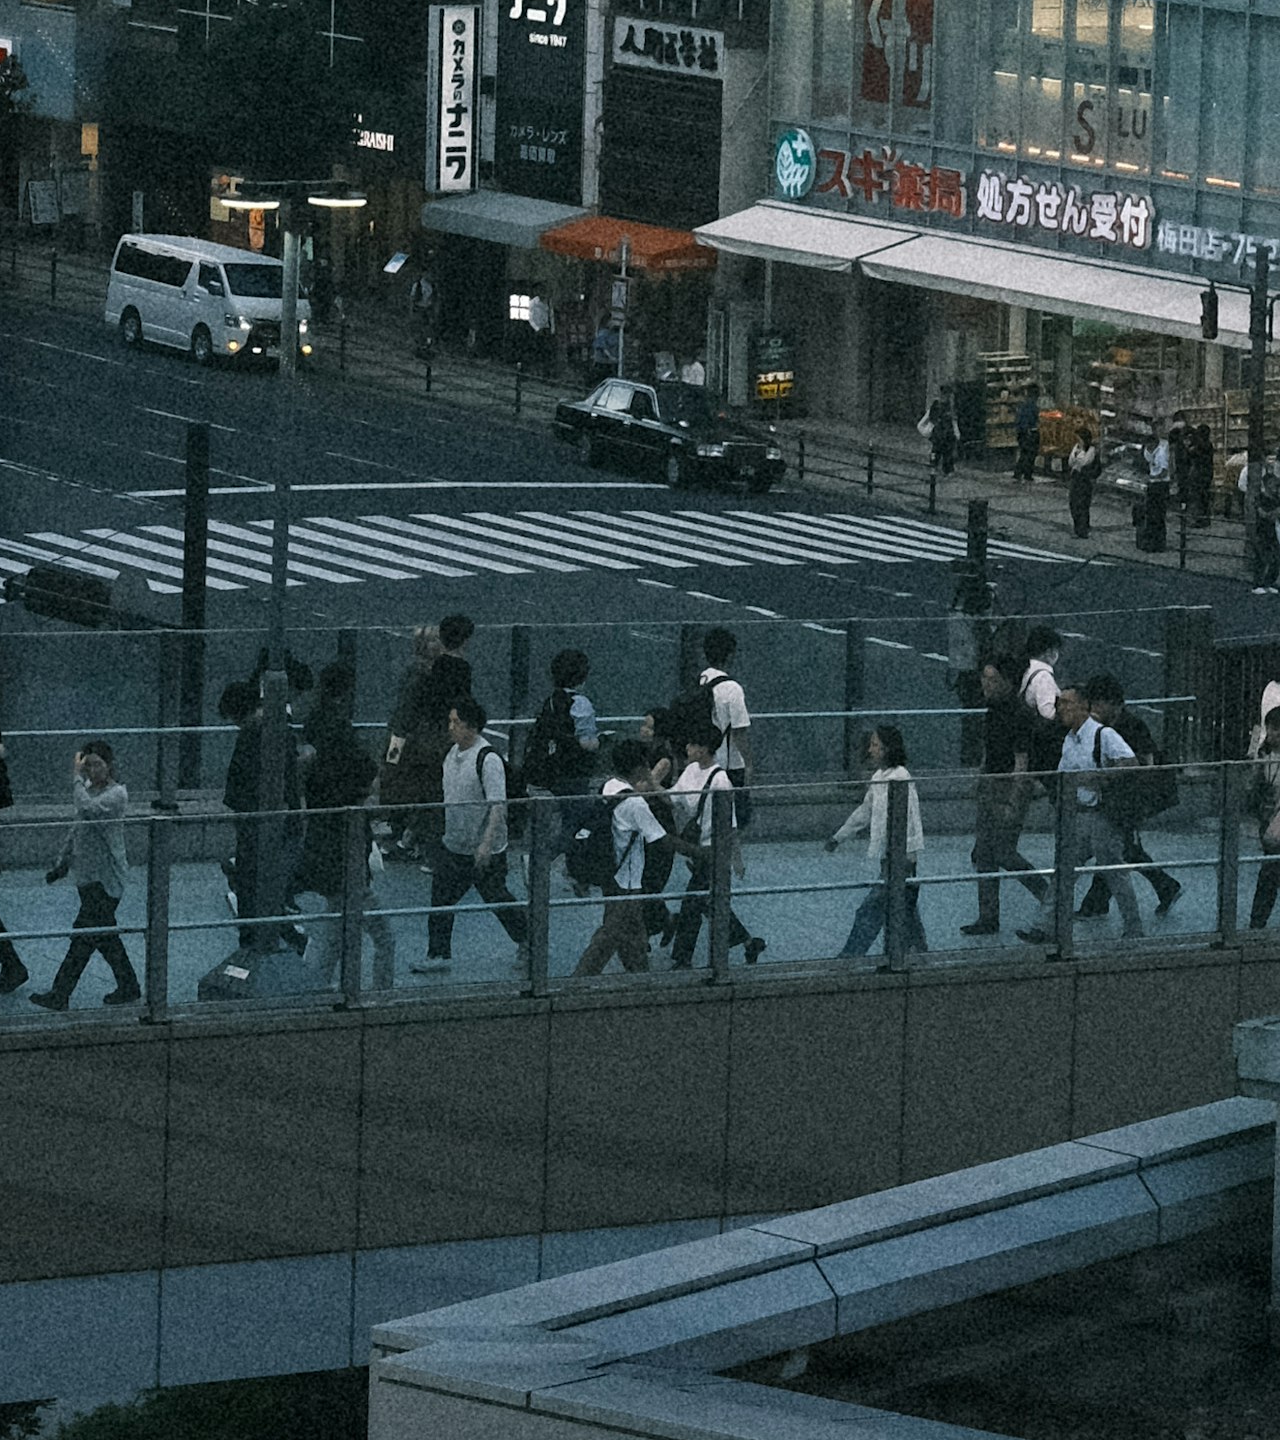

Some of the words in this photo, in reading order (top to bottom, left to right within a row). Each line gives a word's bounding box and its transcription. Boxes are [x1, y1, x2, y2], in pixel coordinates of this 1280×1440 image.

[445, 38, 468, 181] カメラのナニワ
[817, 145, 966, 220] スギ薬局
[976, 167, 1156, 249] 処方せん受付
